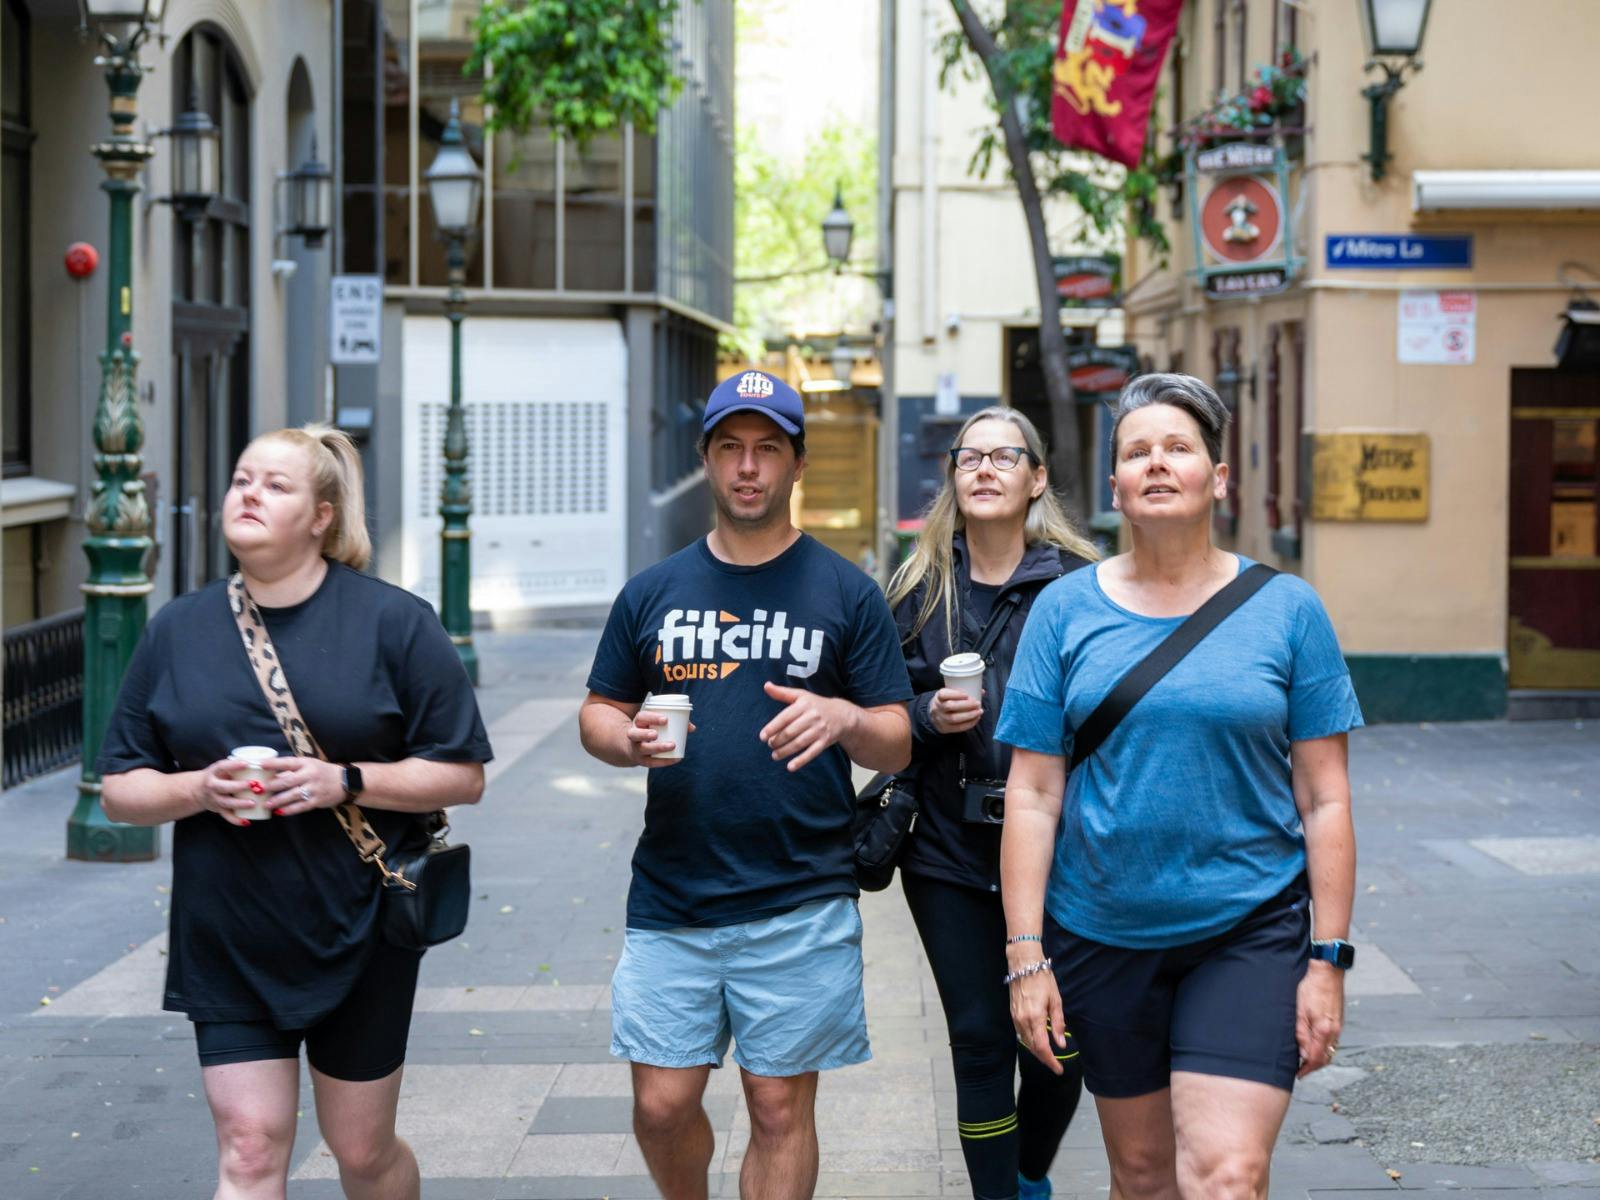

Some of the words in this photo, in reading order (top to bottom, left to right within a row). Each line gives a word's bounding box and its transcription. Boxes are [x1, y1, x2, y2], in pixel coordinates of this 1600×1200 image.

[1345, 239, 1396, 259] Mitre
[1401, 239, 1424, 259] La
[663, 663, 718, 682] tours
